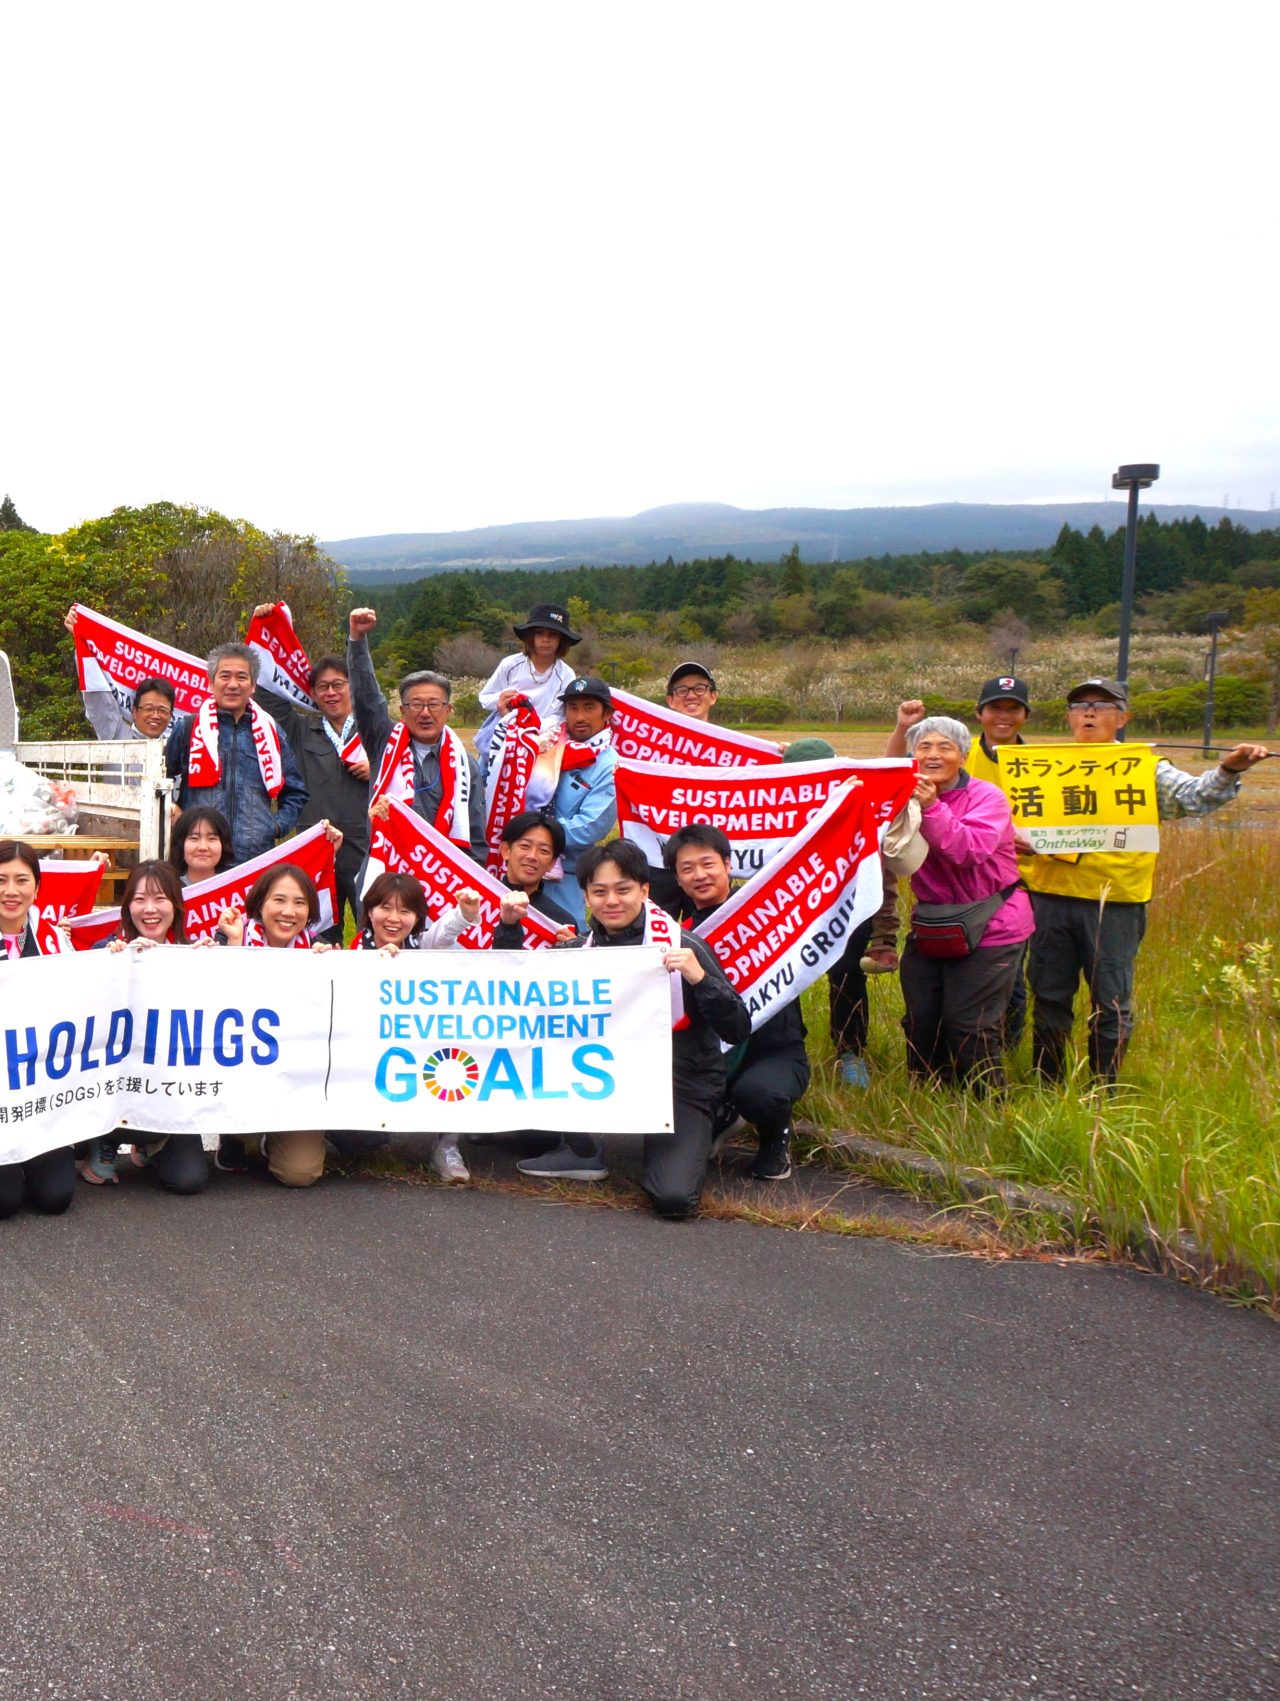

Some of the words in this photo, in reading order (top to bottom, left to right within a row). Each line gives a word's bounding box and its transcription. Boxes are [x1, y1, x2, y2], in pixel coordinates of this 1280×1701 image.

[189, 725, 205, 775] ALS
[1006, 757, 1142, 778] ボランティア
[631, 802, 798, 832] EVELOPMENT
[1010, 784, 1147, 817] 活動中
[1035, 838, 1106, 849] OntheWay
[713, 852, 826, 960] STAINABLE
[724, 905, 803, 985] OPMENT
[807, 831, 866, 909] GOALS
[379, 978, 612, 1006] SUSTAINABLE
[747, 961, 795, 1019] AKYU
[379, 1012, 612, 1039] DEVELOPMENT
[5, 1008, 281, 1091] HOLDINGS
[375, 1043, 615, 1102] GOALS
